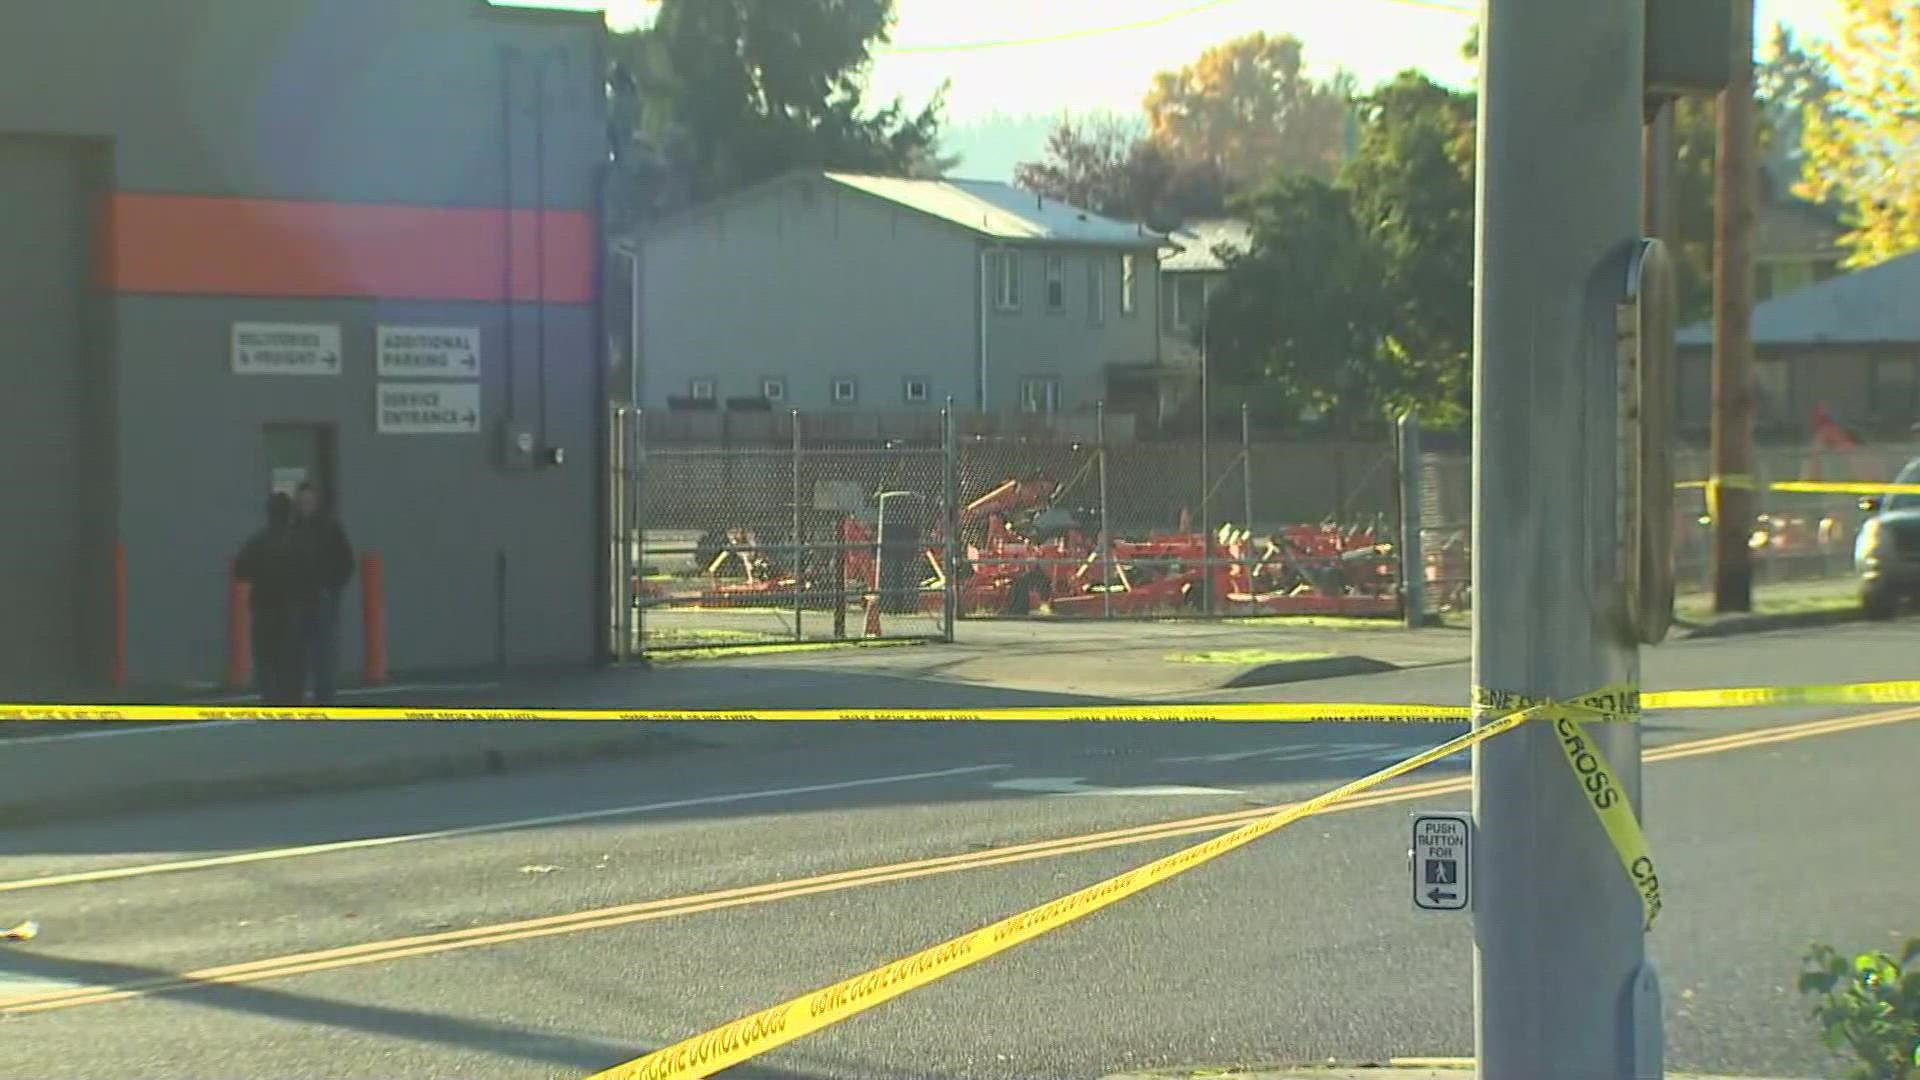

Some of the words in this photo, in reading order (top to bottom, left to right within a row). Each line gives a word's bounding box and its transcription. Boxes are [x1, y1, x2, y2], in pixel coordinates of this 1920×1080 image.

[383, 335, 470, 350] ADDITIONAL
[383, 352, 448, 367] PARKING
[383, 392, 439, 406] SERVICE
[383, 409, 459, 424] ENTRANCE
[1557, 718, 1620, 810] CROSS
[1425, 823, 1457, 834] PUSH
[1418, 835, 1463, 846] BUTTON
[1429, 847, 1453, 858] FOR
